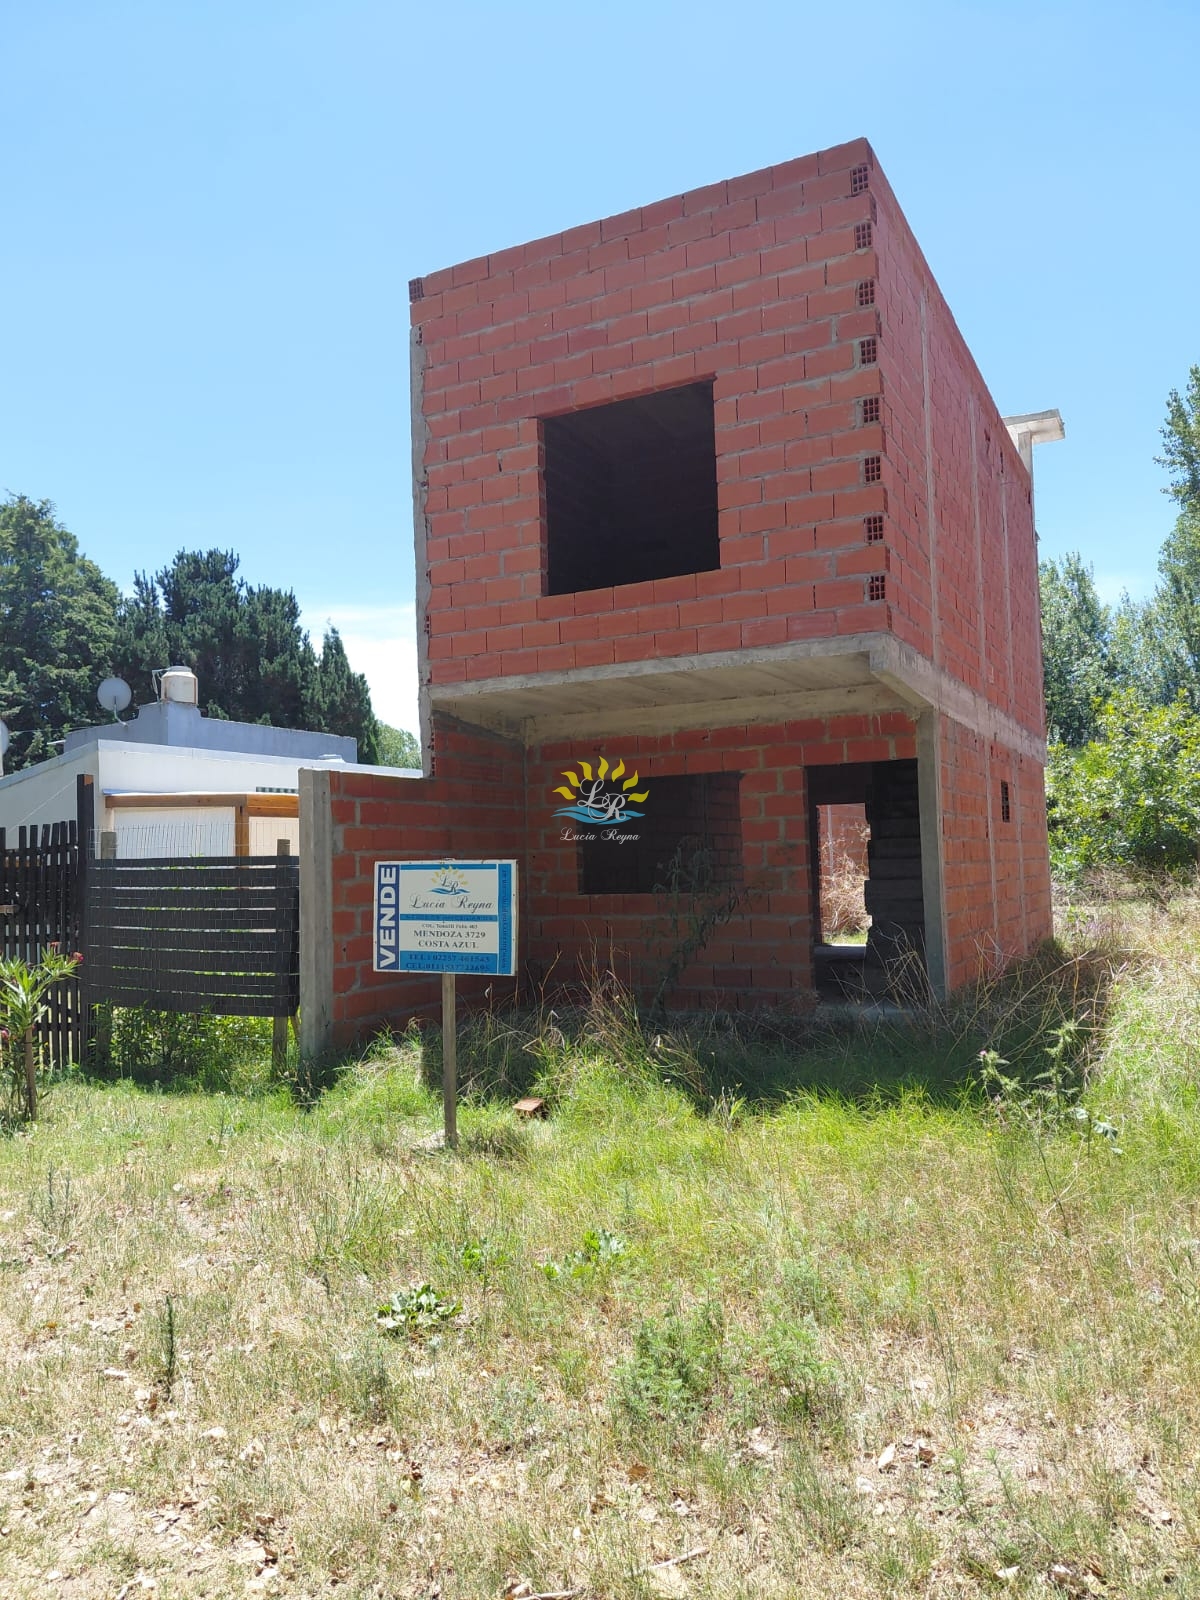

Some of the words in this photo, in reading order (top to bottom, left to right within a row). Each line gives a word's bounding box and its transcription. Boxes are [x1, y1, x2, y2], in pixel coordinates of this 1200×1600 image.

[410, 893, 446, 909] Lucia
[456, 895, 494, 913] Reyna
[379, 867, 397, 968] VENDE
[413, 930, 462, 938] MENDOZA
[465, 931, 486, 939] 3729
[418, 940, 450, 948] COSTA
[452, 941, 479, 949] AZUL
